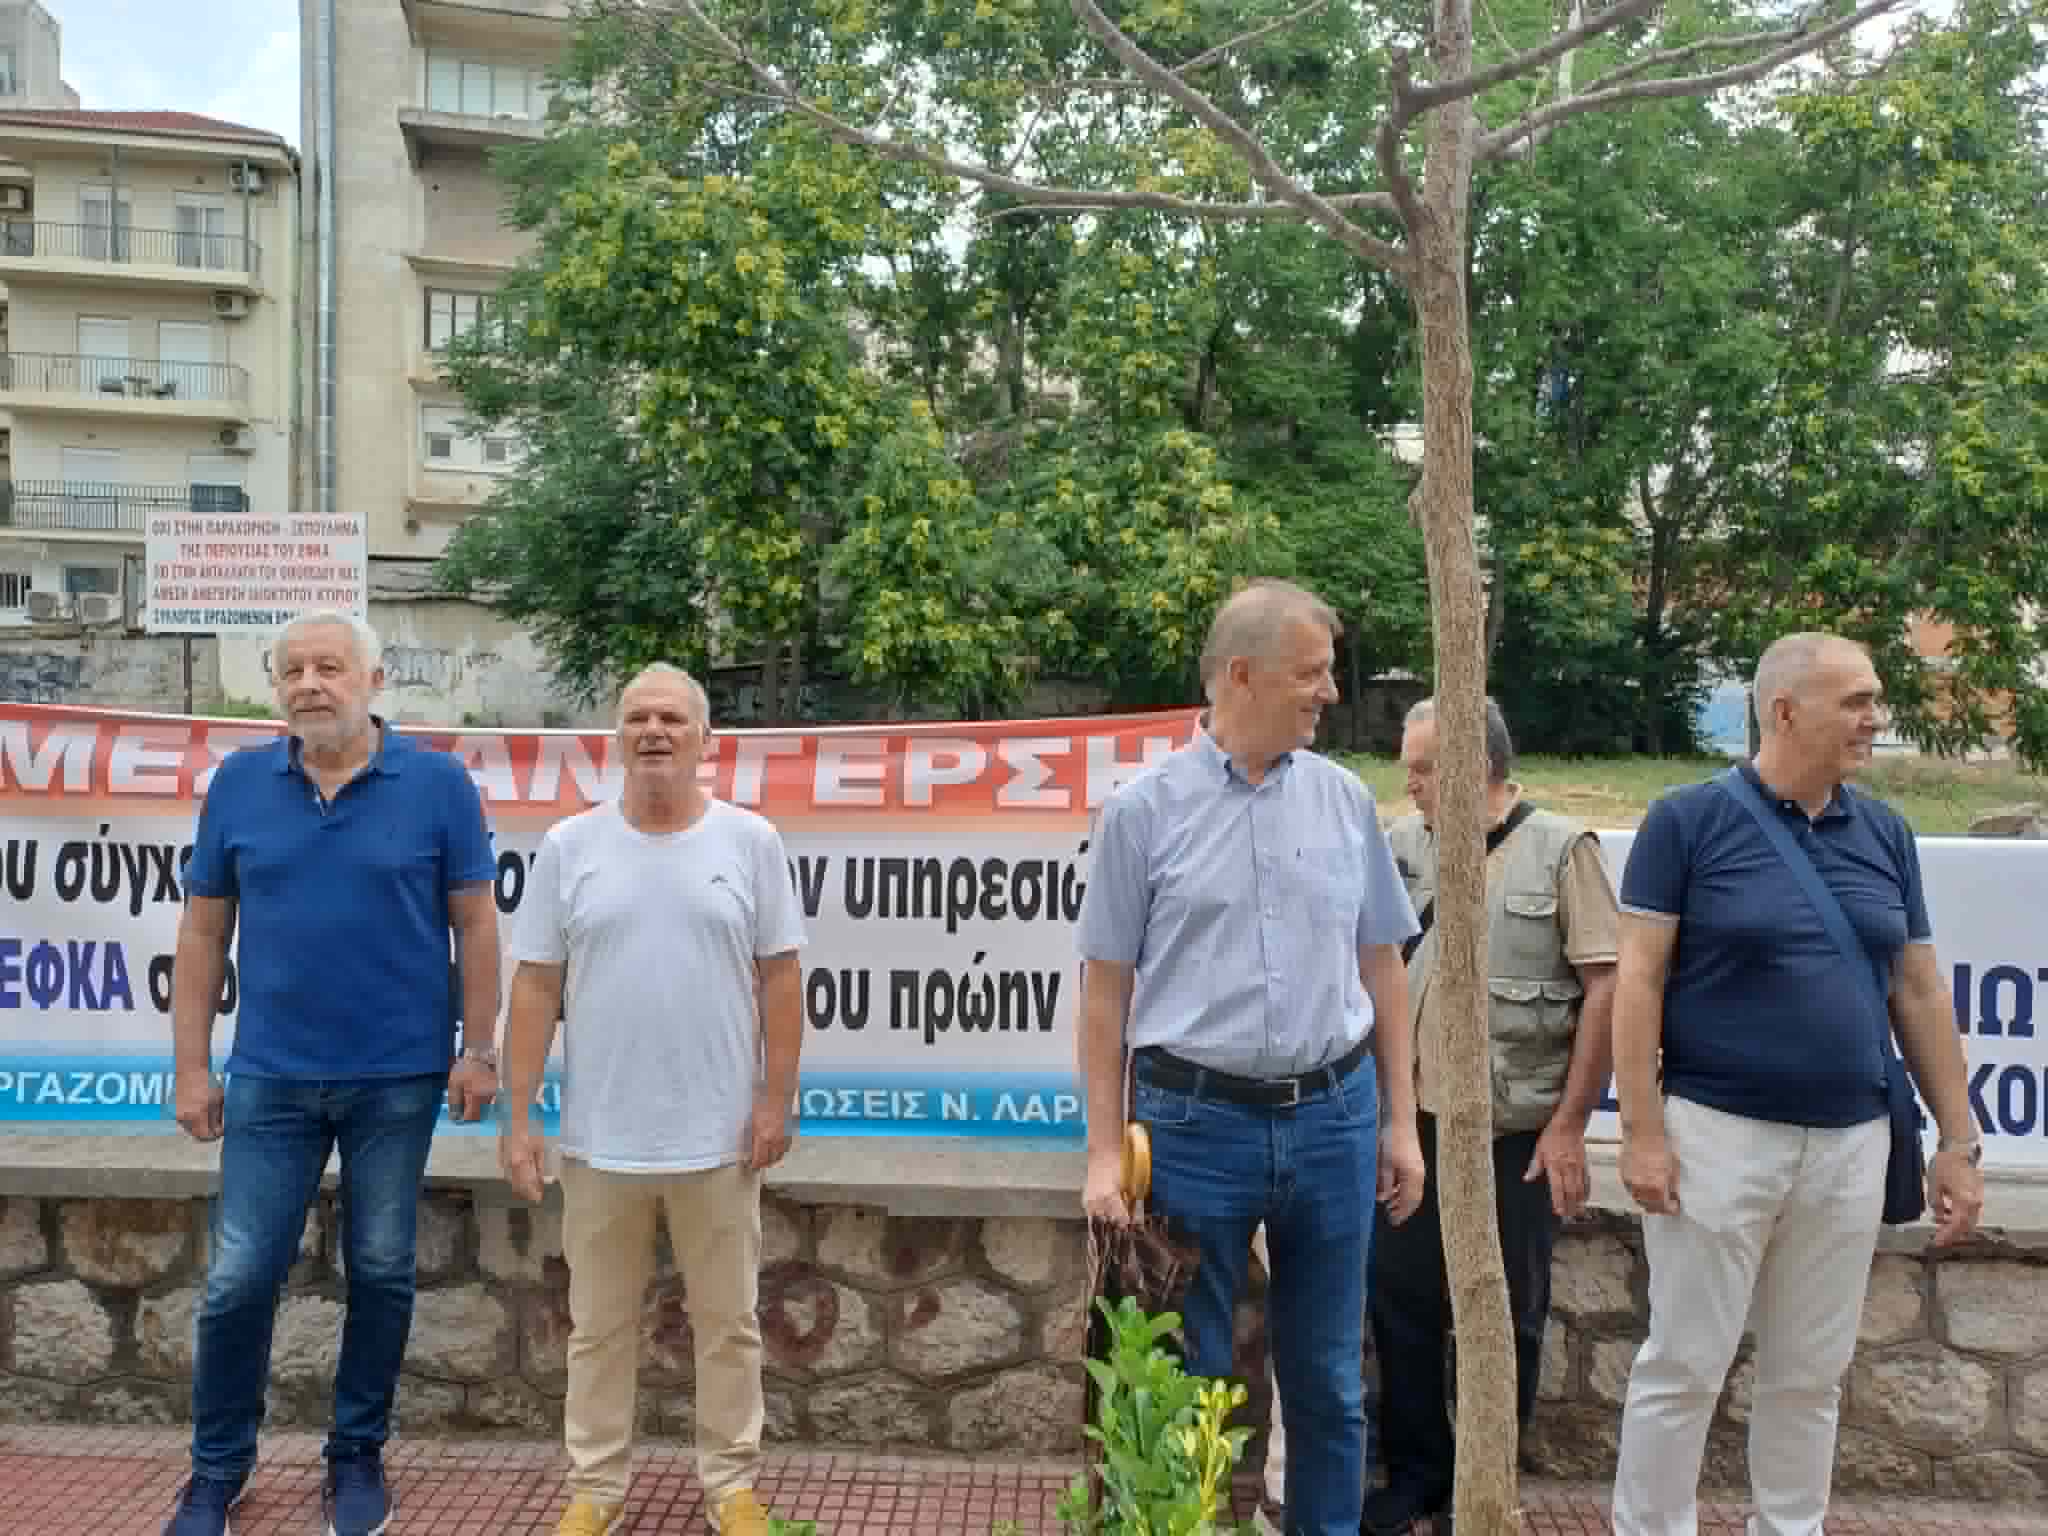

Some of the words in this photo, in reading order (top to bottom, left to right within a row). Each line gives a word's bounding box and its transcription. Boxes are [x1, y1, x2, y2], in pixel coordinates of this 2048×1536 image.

[273, 543, 295, 559] ΤΟΥ
[889, 951, 1061, 1045] πρώην
[792, 1088, 929, 1120] ΩΣΕΙΣ
